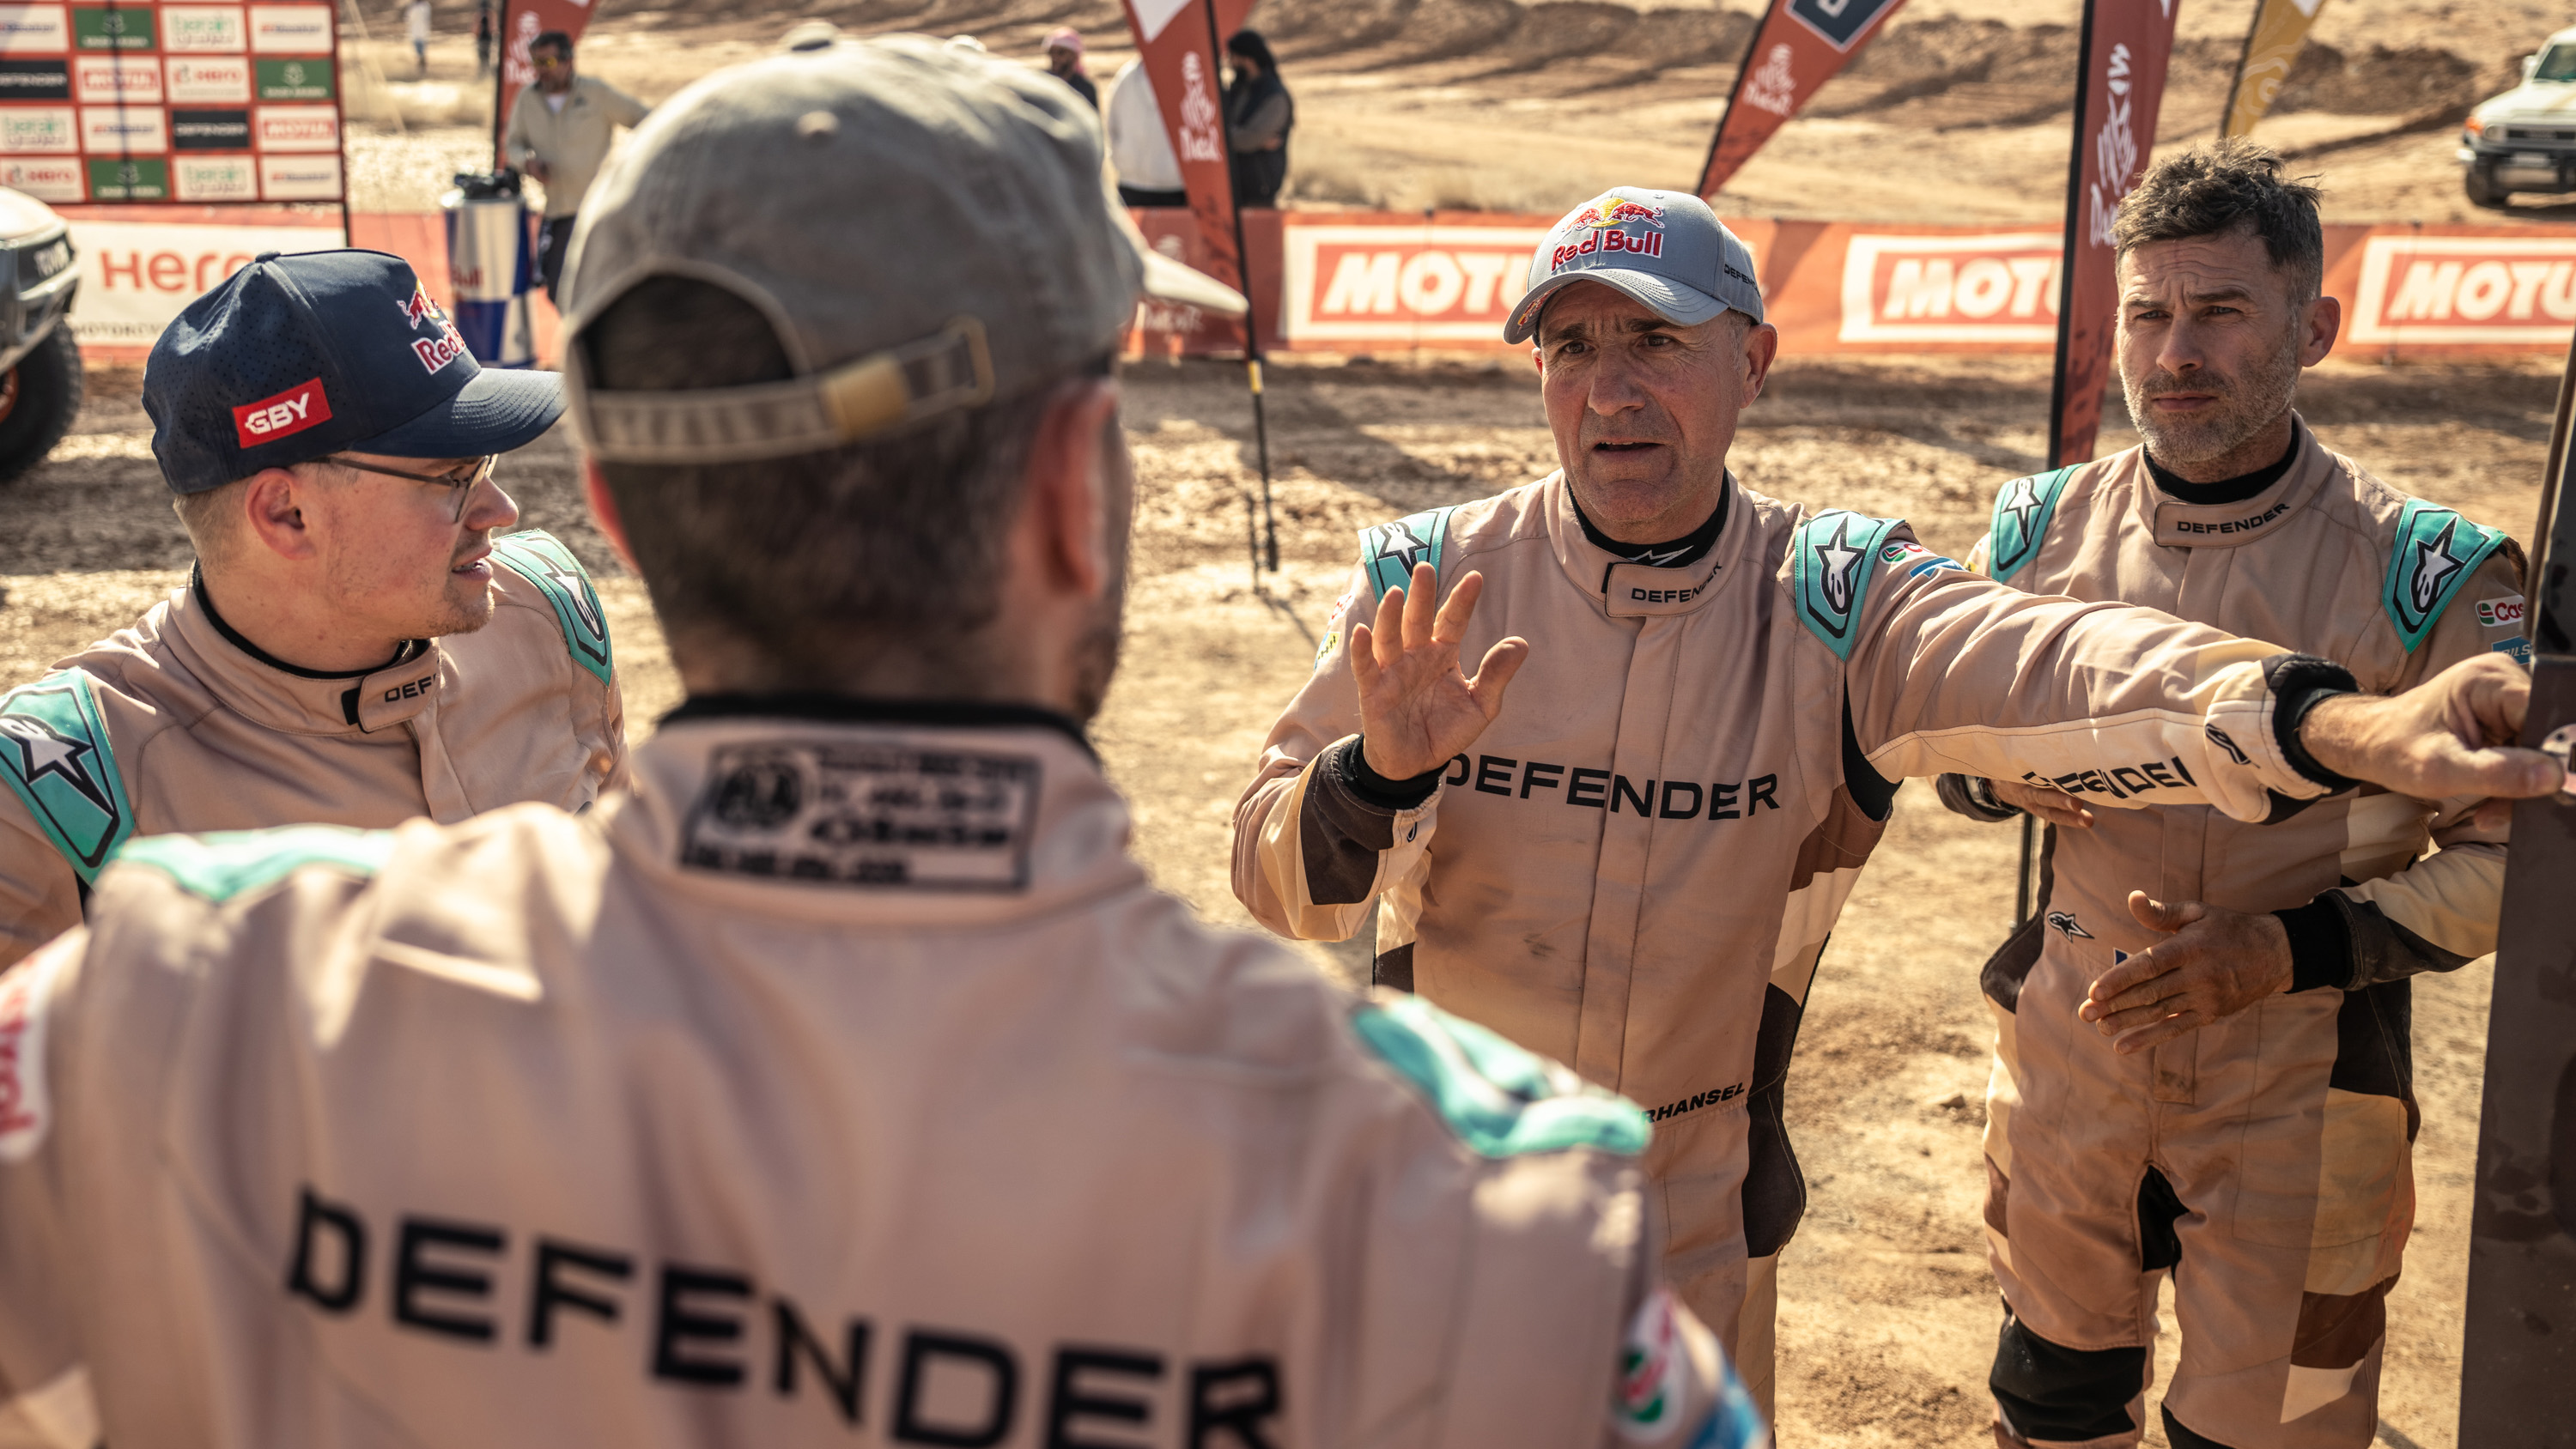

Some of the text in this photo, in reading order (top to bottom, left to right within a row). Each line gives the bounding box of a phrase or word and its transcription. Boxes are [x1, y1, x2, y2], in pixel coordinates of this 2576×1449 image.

[1552, 229, 1662, 271] Red Bull
[416, 324, 460, 372] Red
[245, 392, 309, 434] GBY
[2177, 503, 2290, 534] DEFENDER
[385, 673, 436, 702] DEF
[1446, 753, 1780, 820] DEFENDER
[286, 1185, 1288, 1449] DEFENDER
